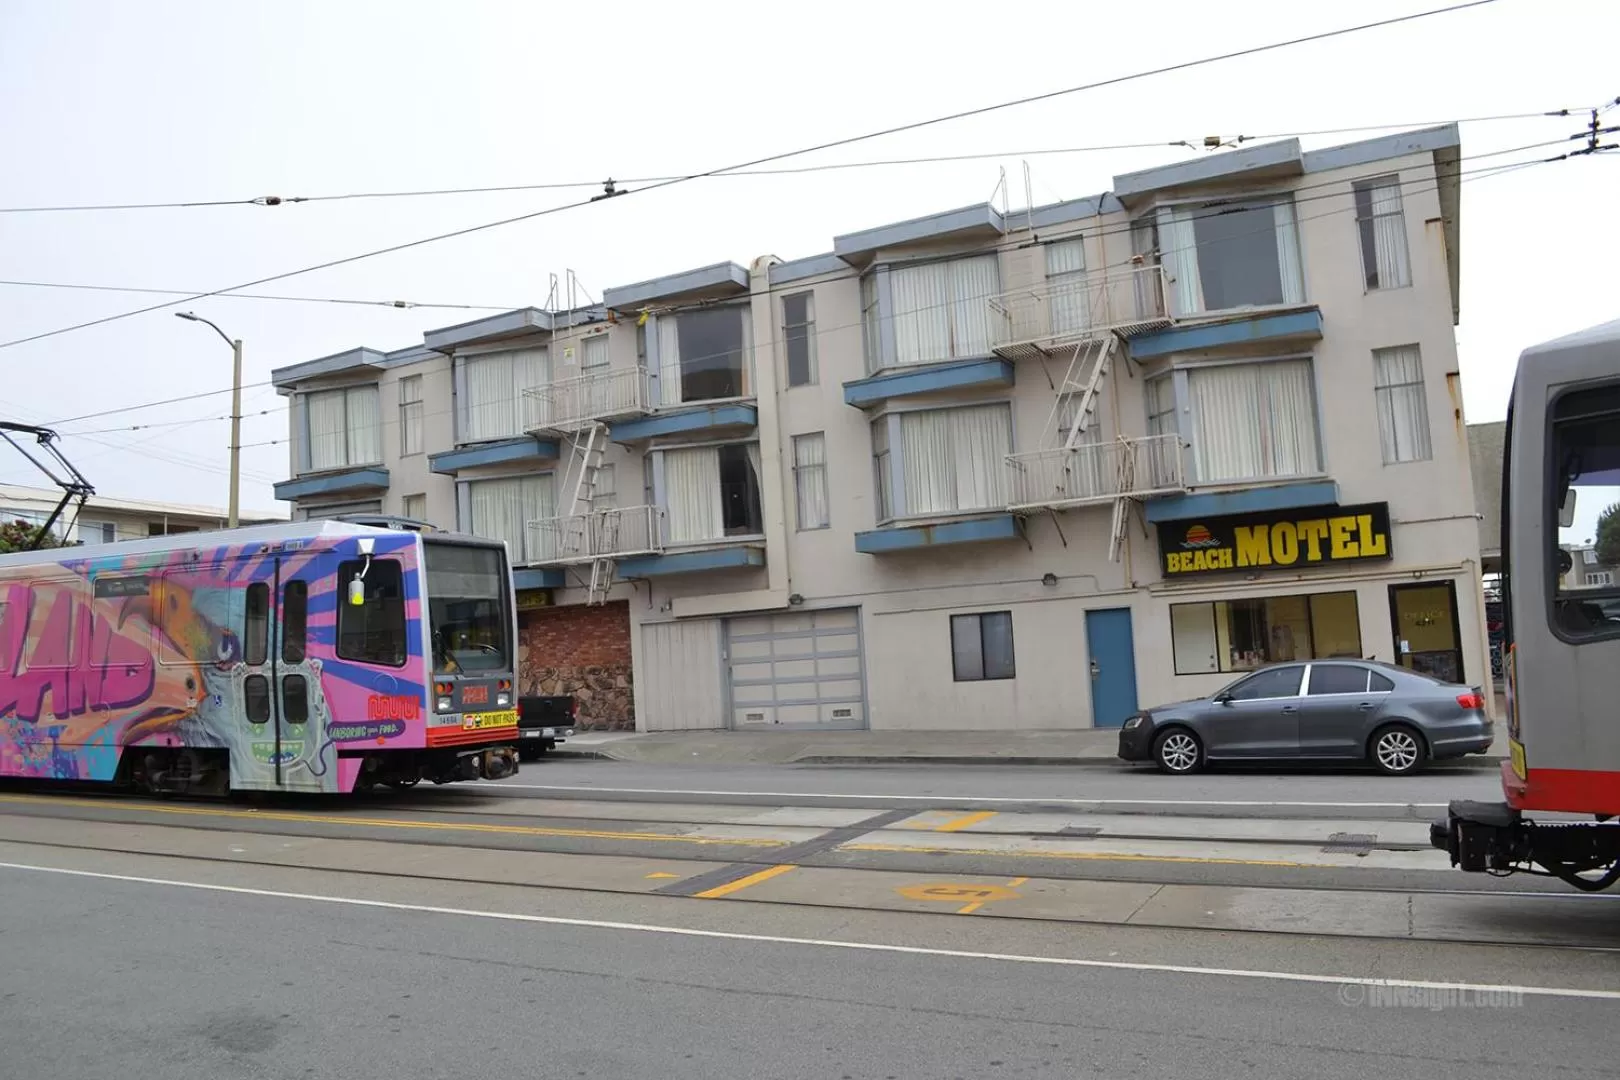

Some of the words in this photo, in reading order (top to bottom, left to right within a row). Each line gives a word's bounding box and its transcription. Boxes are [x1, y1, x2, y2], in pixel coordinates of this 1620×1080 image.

[1166, 547, 1234, 573] BEACH
[1234, 514, 1386, 567] MOTEL
[484, 714, 492, 726] DO
[493, 713, 502, 724] NOT
[503, 712, 515, 724] PASS
